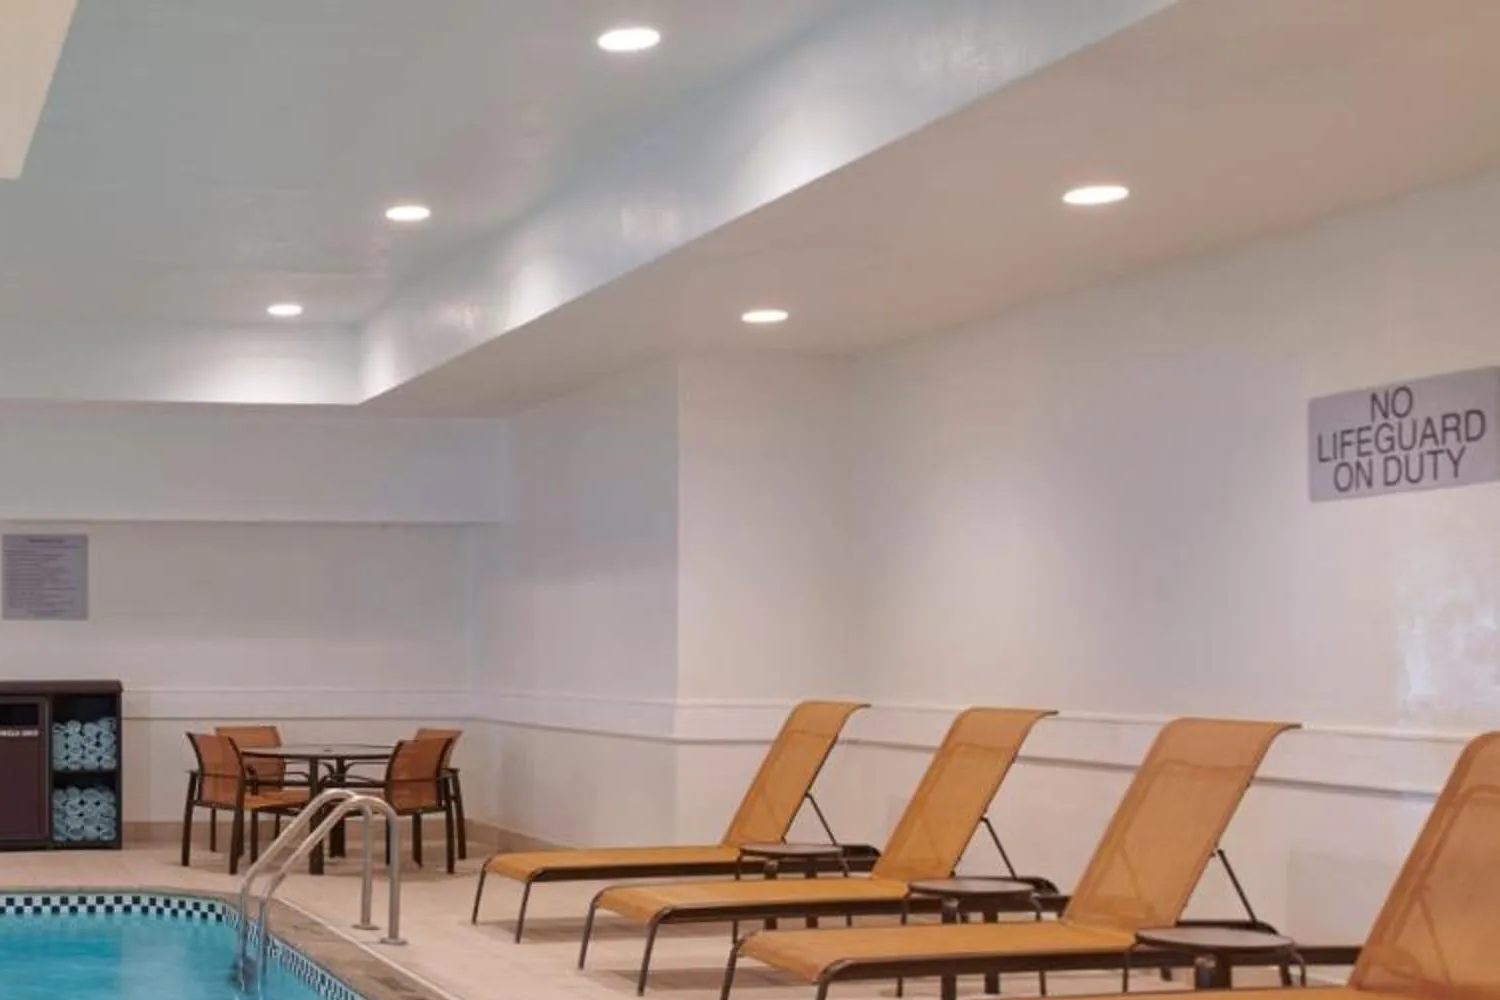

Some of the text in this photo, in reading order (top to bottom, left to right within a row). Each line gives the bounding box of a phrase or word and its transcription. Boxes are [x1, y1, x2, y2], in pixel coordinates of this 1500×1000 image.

[1370, 385, 1414, 422] NO
[1317, 409, 1486, 464] LIFEGUARD
[1333, 446, 1467, 493] ON DUTY
